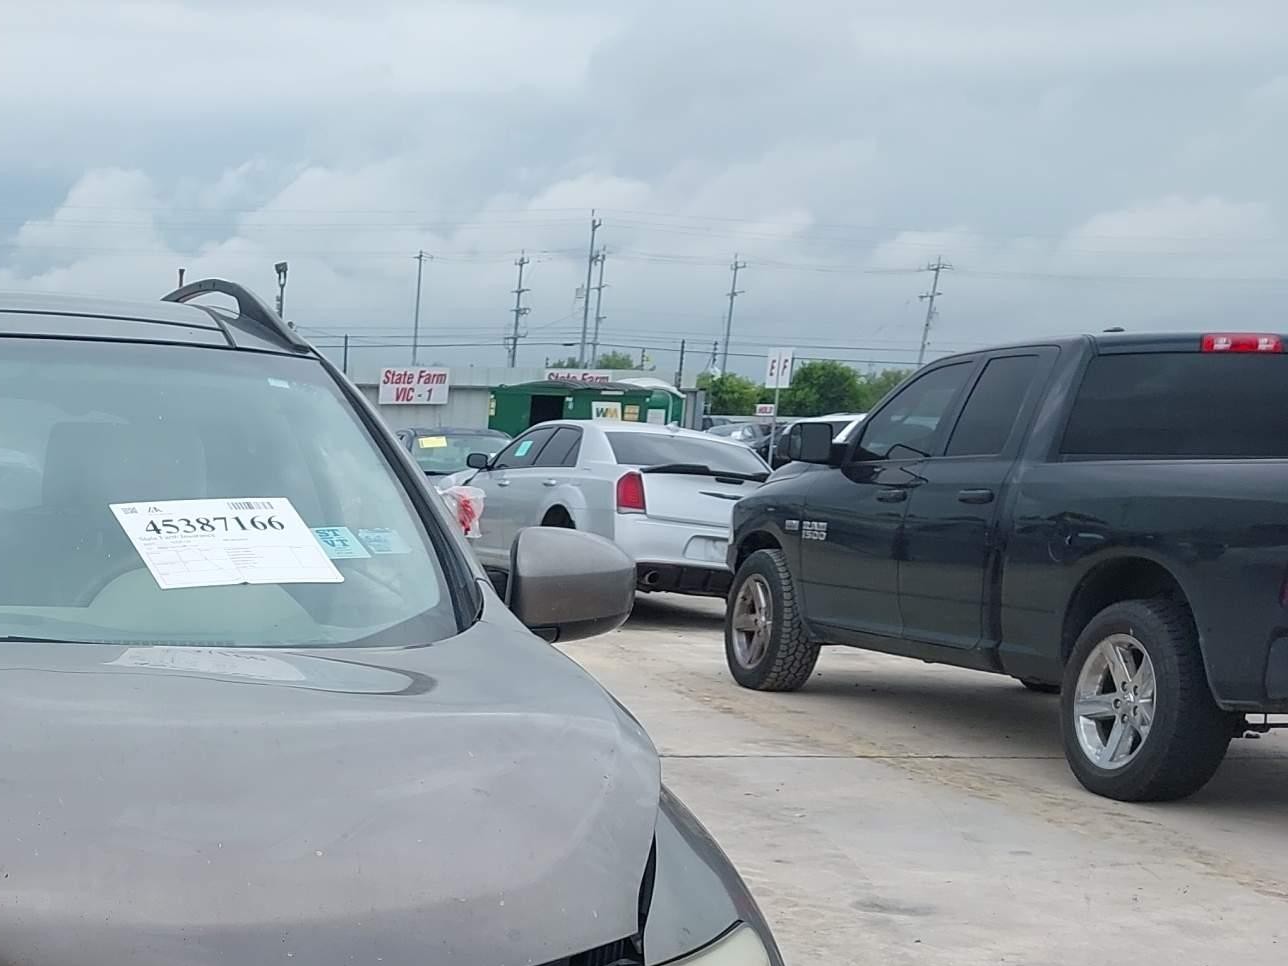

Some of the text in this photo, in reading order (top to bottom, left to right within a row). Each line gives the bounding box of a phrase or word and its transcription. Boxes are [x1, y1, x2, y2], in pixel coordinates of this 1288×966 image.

[383, 369, 448, 385] State Farm
[395, 387, 415, 402] VIC
[427, 387, 433, 402] 1
[144, 515, 286, 535] 45387166
